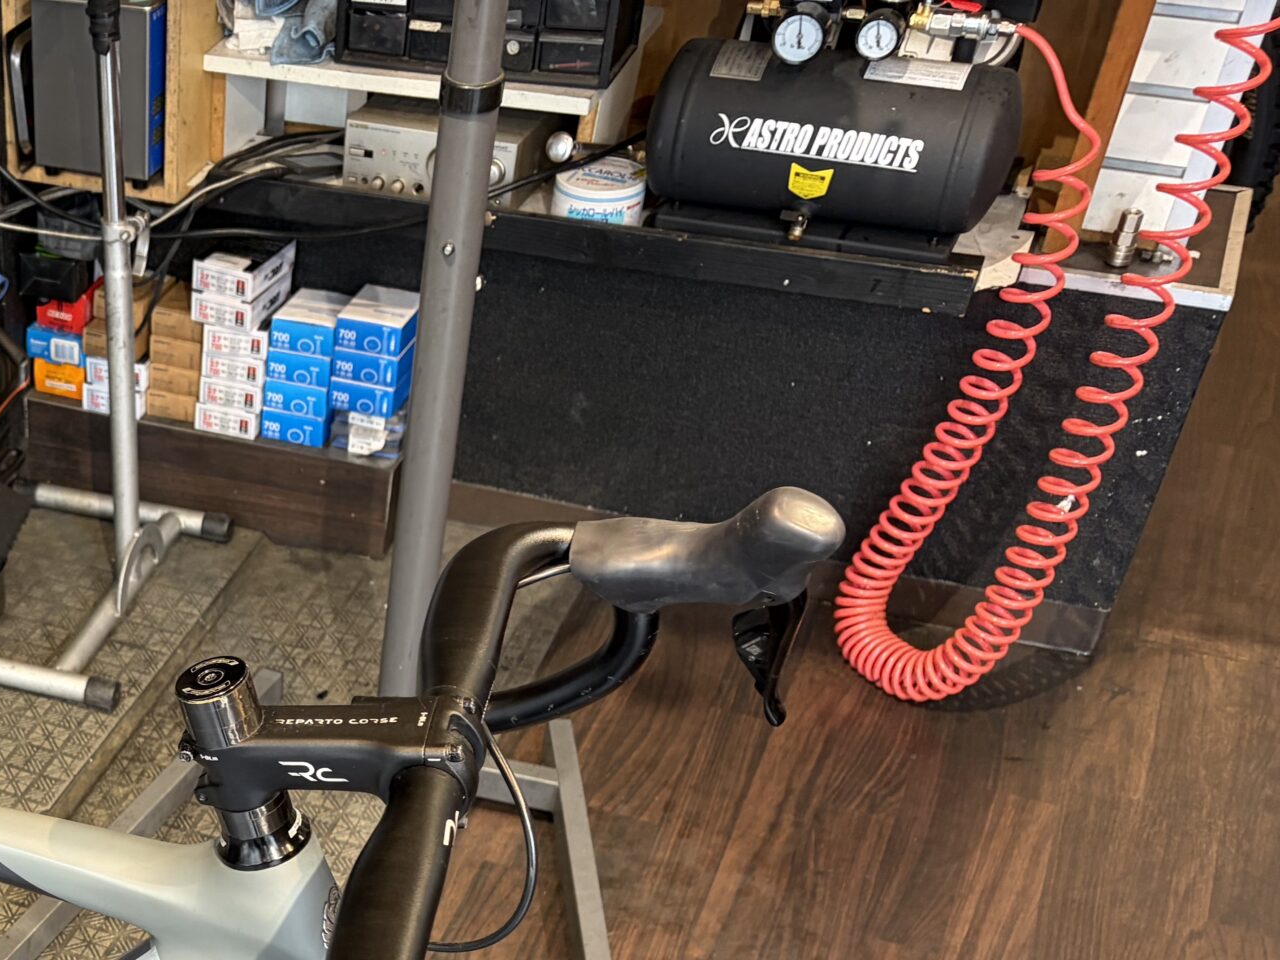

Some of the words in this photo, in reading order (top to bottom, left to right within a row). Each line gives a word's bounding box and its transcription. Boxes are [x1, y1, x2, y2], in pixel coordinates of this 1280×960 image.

[741, 118, 814, 154] ASTRO
[809, 126, 924, 171] PRODUCTS
[272, 331, 290, 342] 700
[339, 328, 357, 339] 700
[269, 362, 286, 373] 700
[335, 360, 353, 371] 700
[266, 392, 284, 403] 700
[332, 390, 349, 402] 700
[263, 421, 280, 432] 700
[275, 717, 343, 726] REPARTO
[348, 716, 399, 725] CORSE
